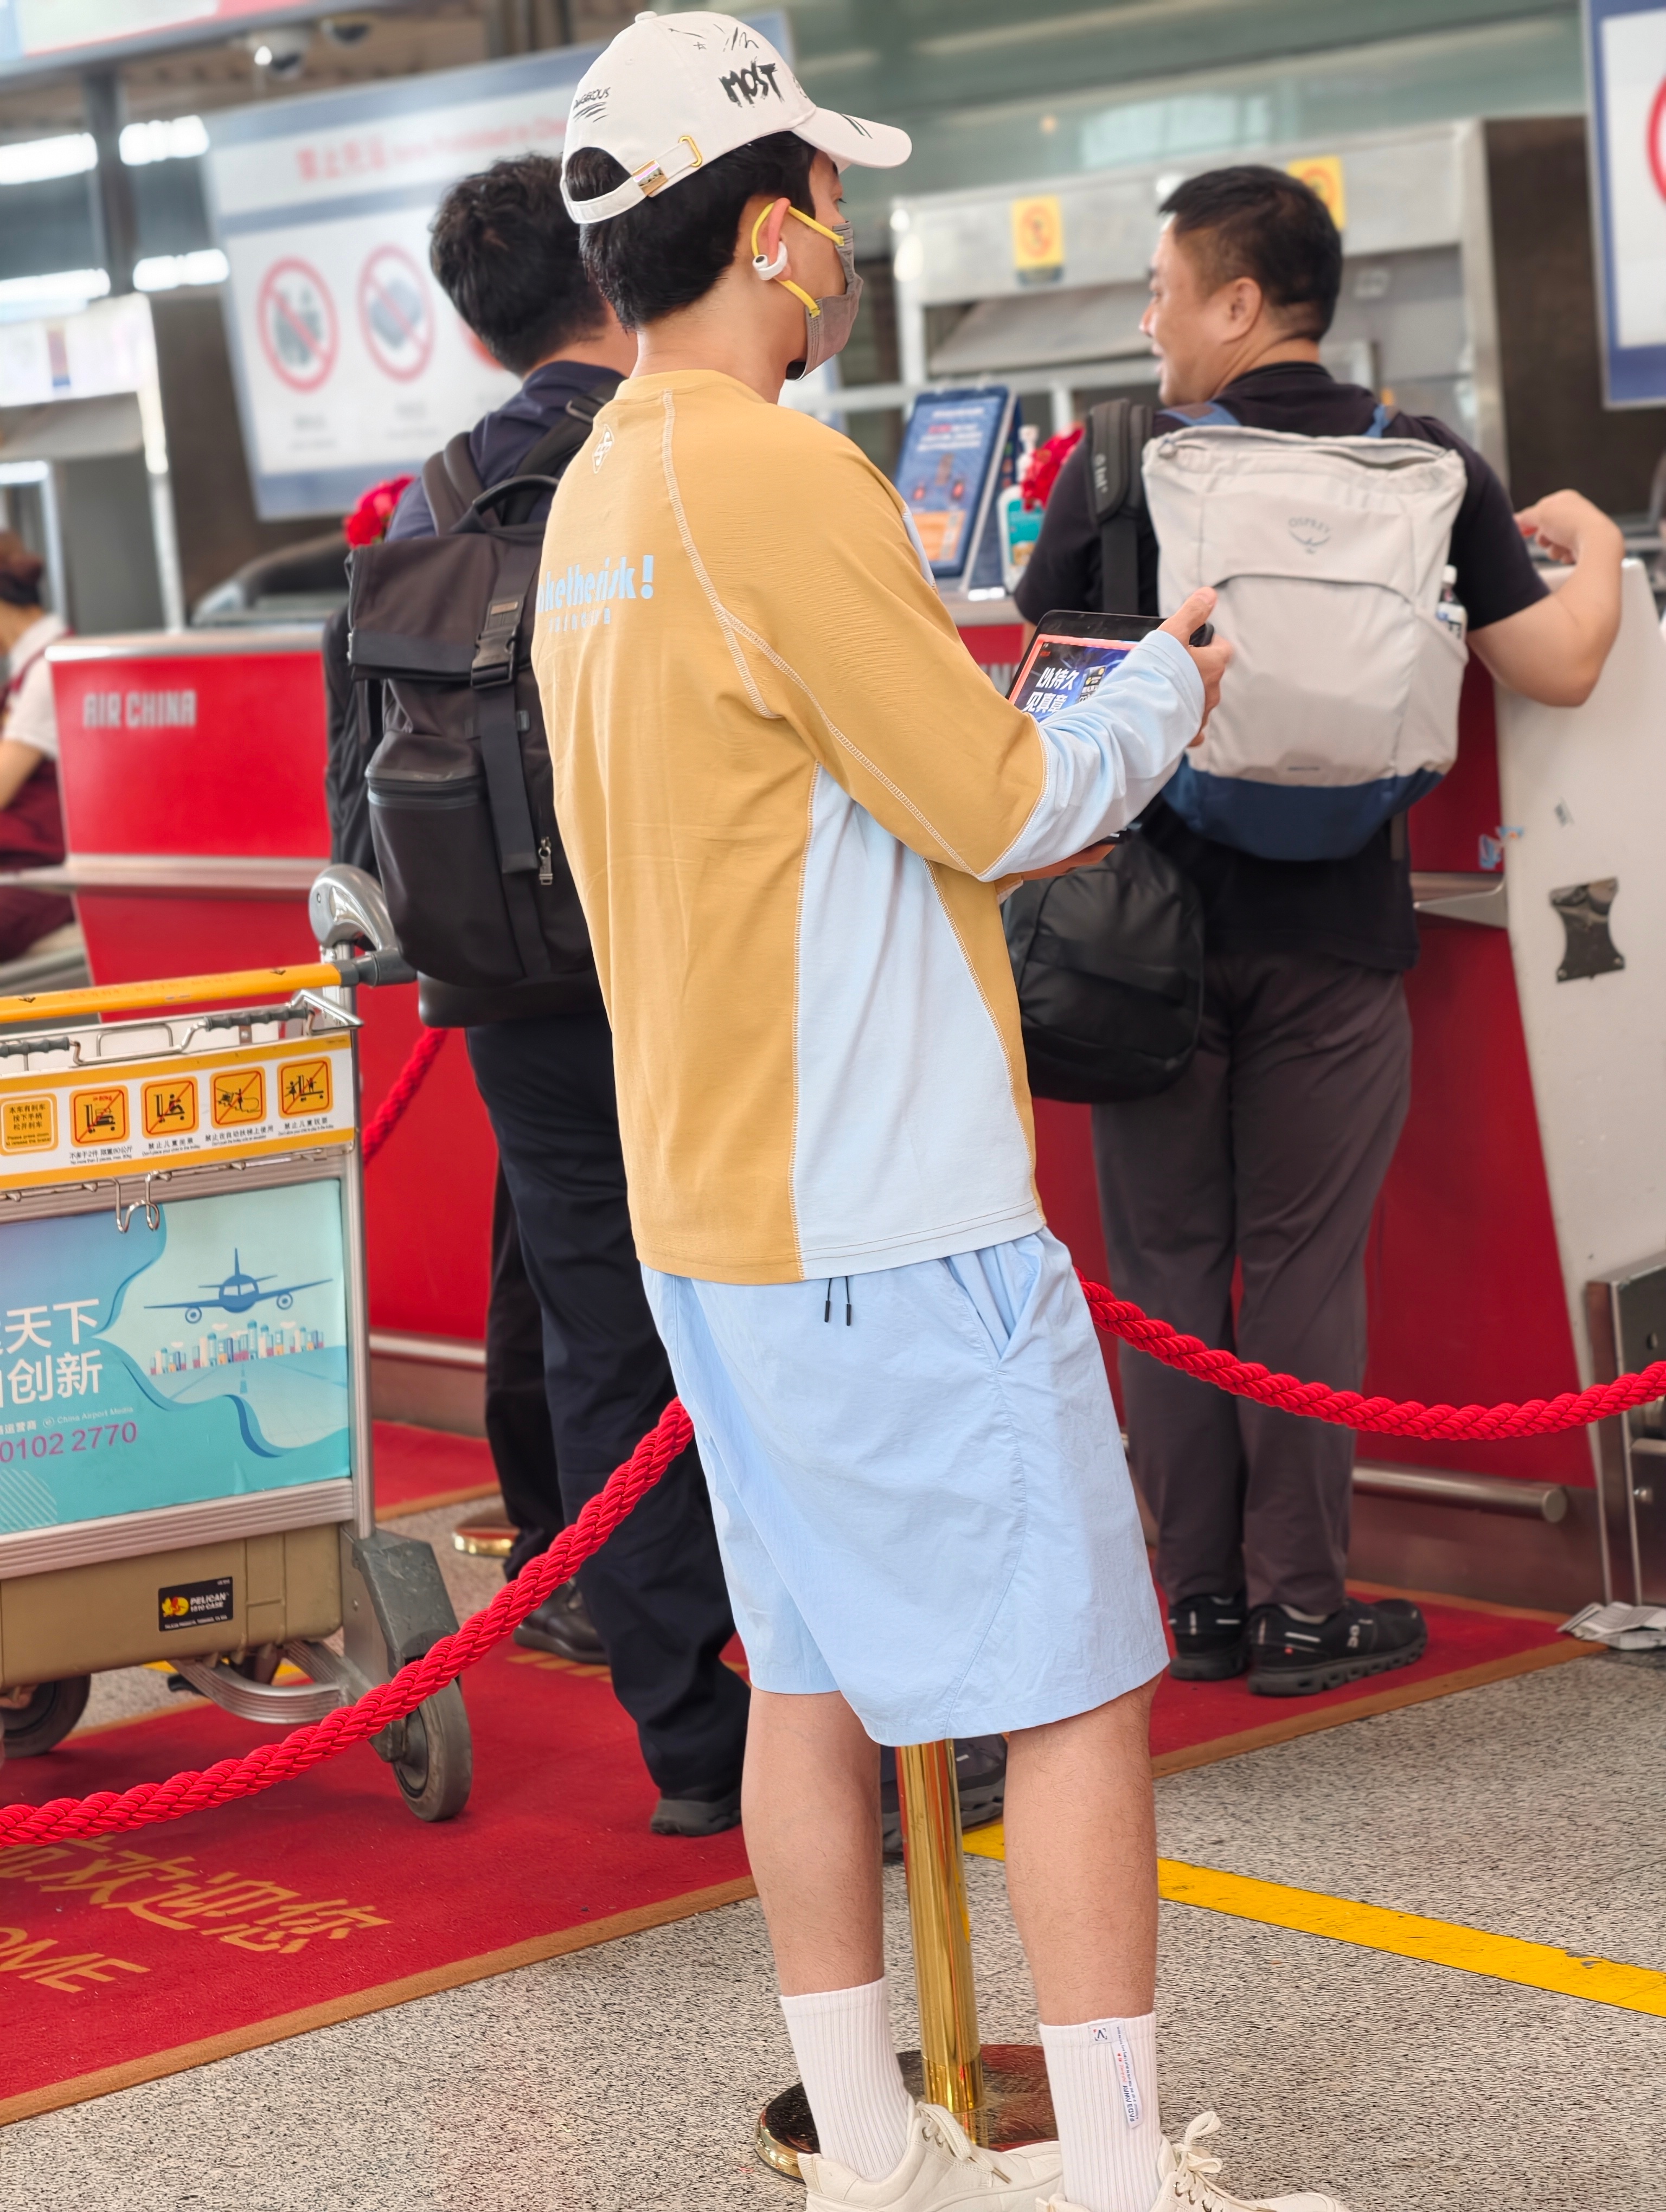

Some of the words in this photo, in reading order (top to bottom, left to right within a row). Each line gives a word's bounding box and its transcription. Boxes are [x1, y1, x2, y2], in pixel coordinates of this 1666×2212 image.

[719, 56, 785, 107] MOST
[1035, 666, 1080, 691] 以持久
[84, 692, 121, 728] AIR
[126, 690, 197, 727] CHINA
[1022, 691, 1068, 713] 见真章
[0, 1298, 99, 1354] 天下
[0, 1349, 102, 1408] 创新
[72, 1420, 137, 1452] 2770
[190, 1592, 226, 1606] PELICAN
[0, 1927, 150, 1993] ME
